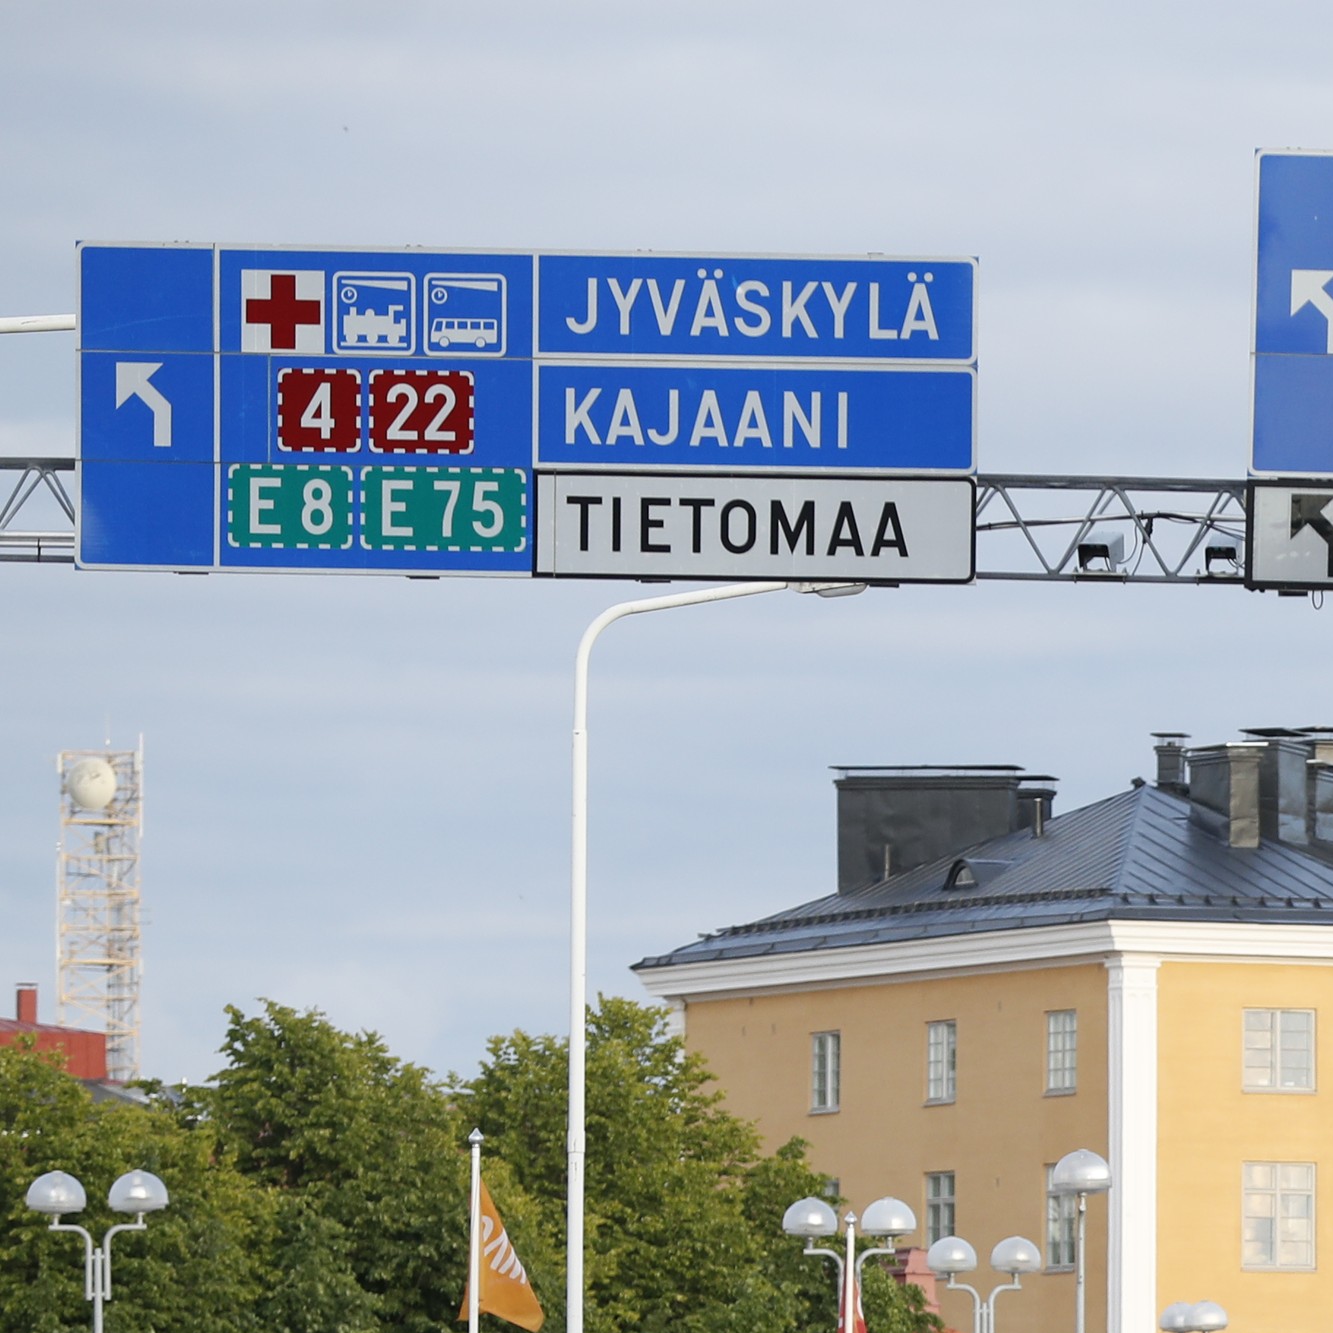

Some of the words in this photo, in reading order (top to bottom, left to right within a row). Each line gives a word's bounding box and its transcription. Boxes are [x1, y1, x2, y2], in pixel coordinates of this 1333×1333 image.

[565, 268, 939, 341] JYVÄSKYLÄ
[300, 382, 335, 440] 4
[386, 382, 456, 442] 22
[565, 387, 848, 449] KAJAANI
[249, 476, 282, 535] E
[301, 478, 334, 535] 8
[381, 479, 414, 537] E
[433, 480, 504, 538] 75
[566, 495, 909, 558] TIETOMAA
